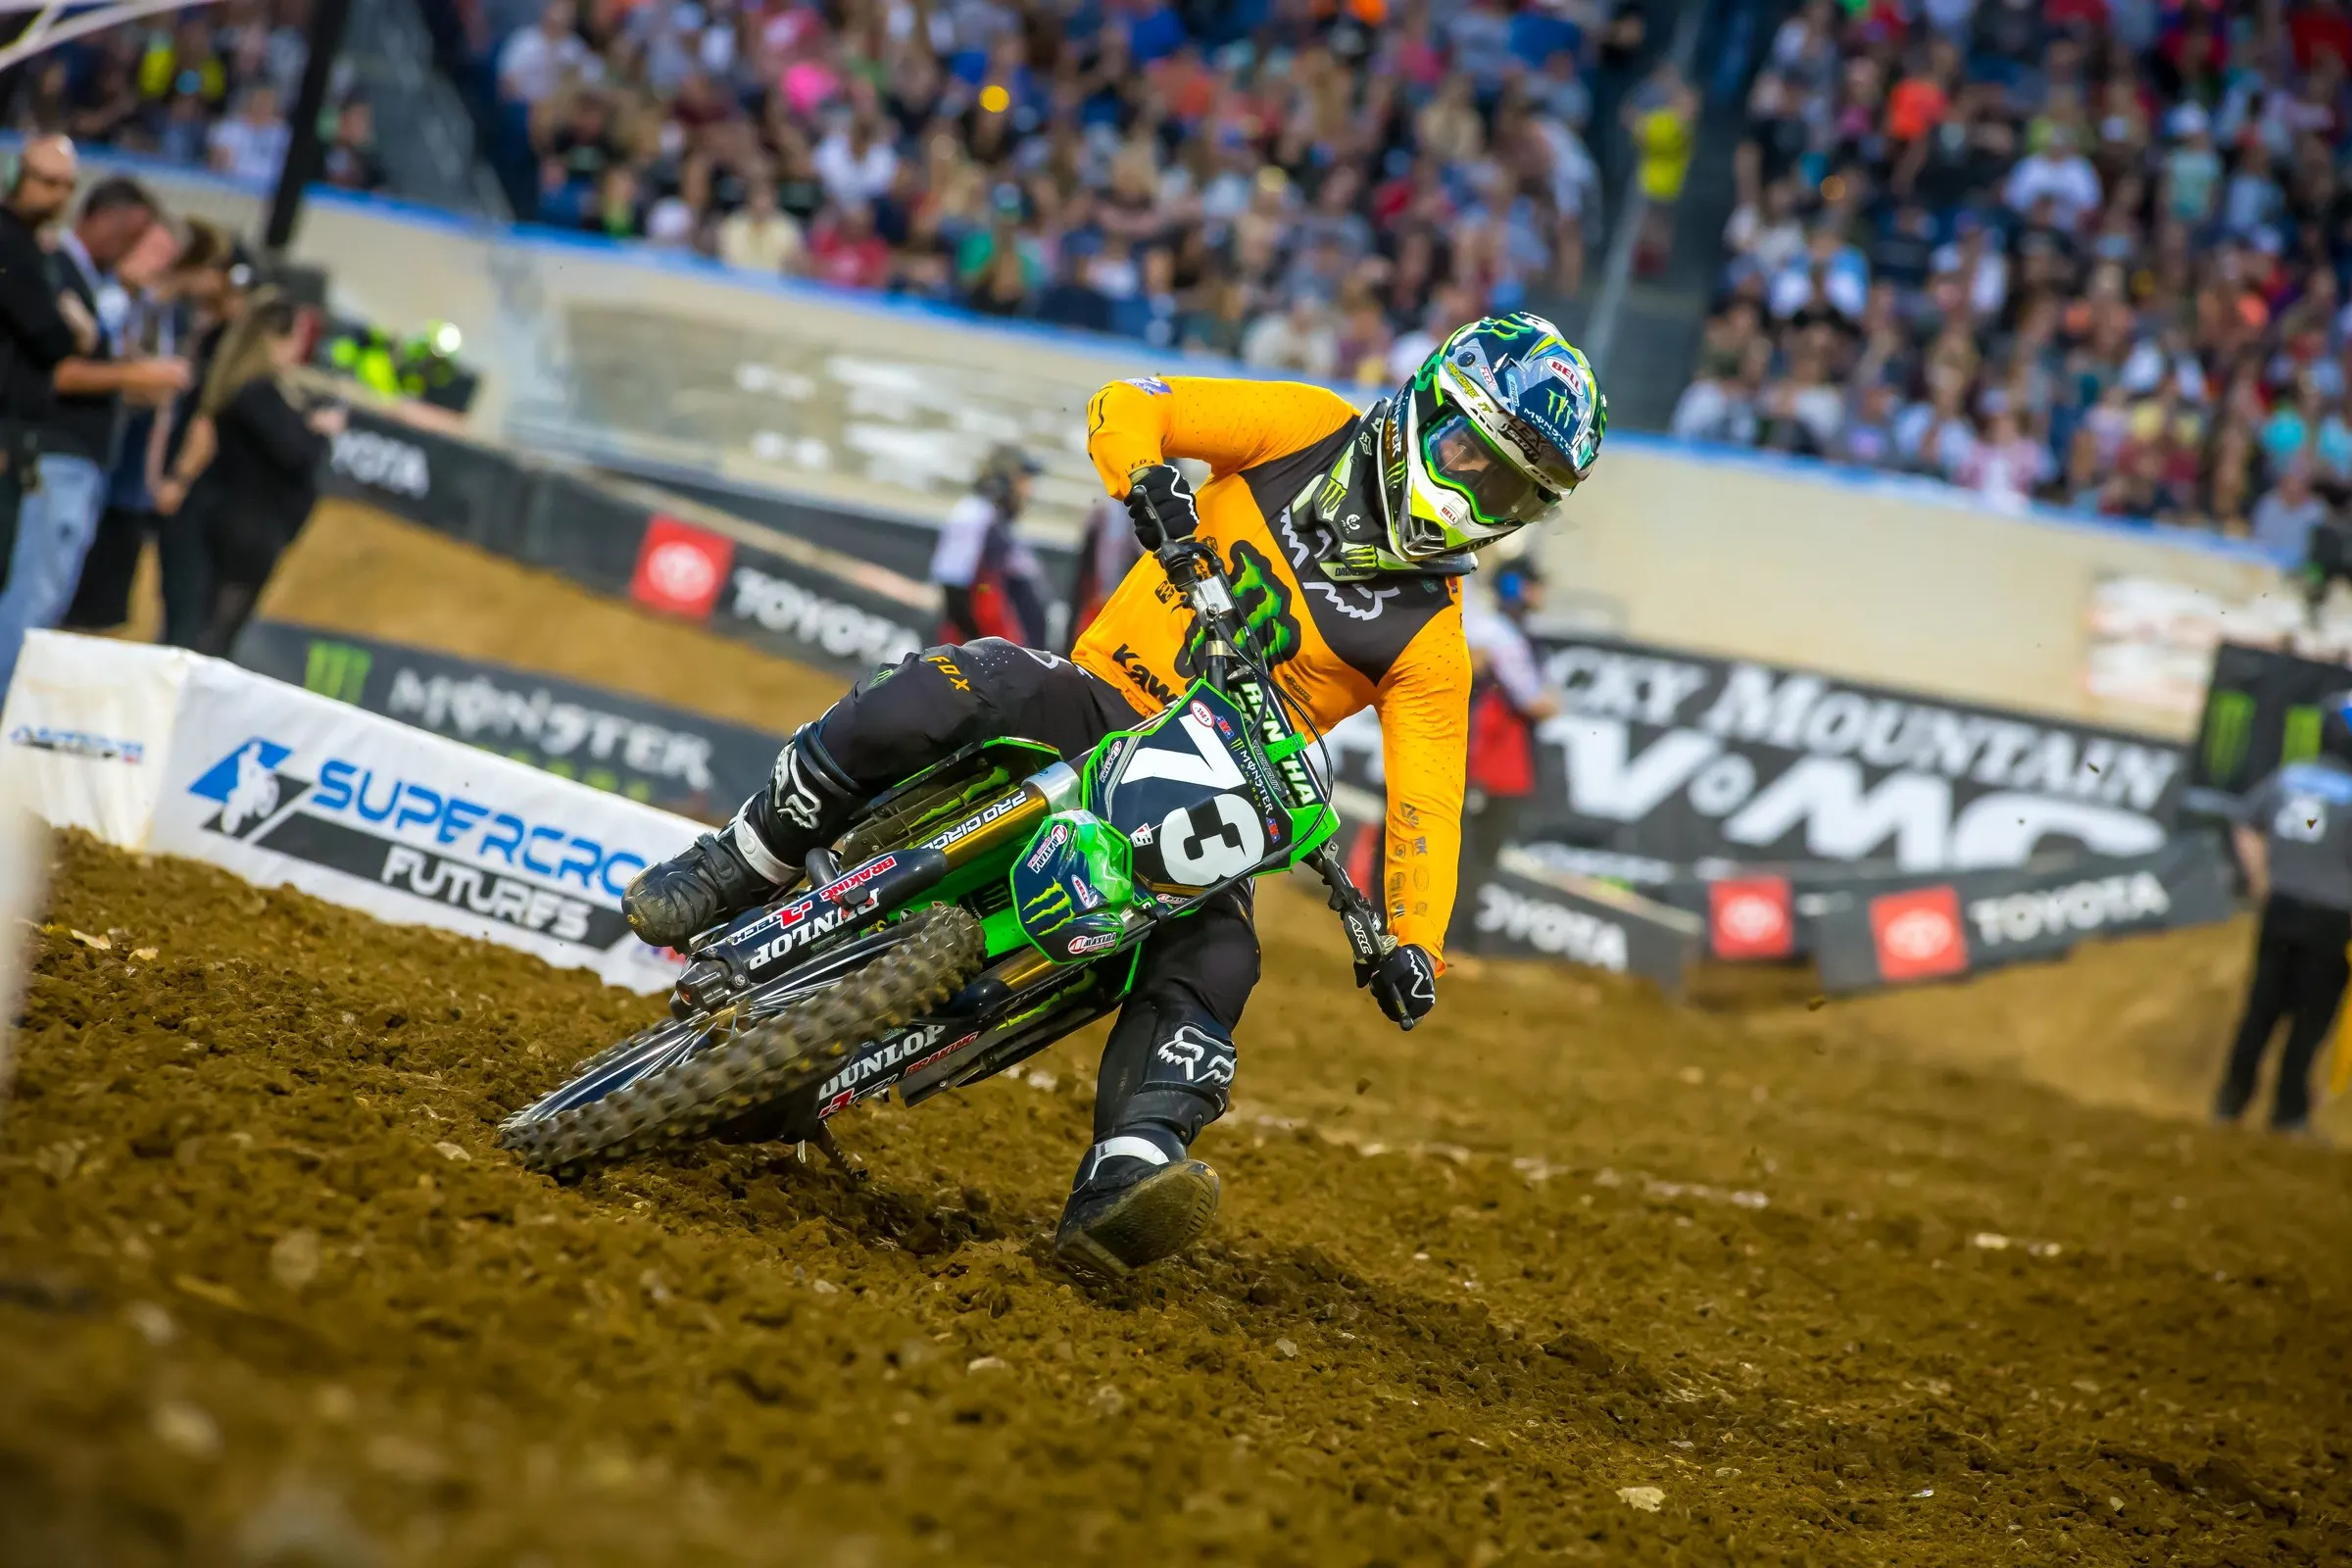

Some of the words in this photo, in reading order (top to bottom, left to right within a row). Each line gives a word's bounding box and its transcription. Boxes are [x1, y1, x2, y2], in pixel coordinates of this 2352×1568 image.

[1551, 360, 1580, 390] BELL
[1523, 408, 1574, 454] MONSTE
[1441, 506, 1457, 523] BELL
[732, 566, 923, 668] TOYOTA
[927, 656, 970, 692] FOX
[388, 668, 715, 791] MONSTER
[1239, 681, 1318, 806] RENHA
[983, 790, 1028, 823] PRO
[1120, 714, 1265, 886] 73
[1240, 750, 1274, 815] MONSTER
[1240, 763, 1261, 808] ENERGY
[313, 760, 649, 899] SUPERCRO
[381, 844, 592, 941] FUTURES
[821, 856, 896, 900] BRAKING
[1074, 879, 1089, 902] BELL
[1348, 914, 1373, 955] ARC
[1970, 872, 2170, 947] TOYOTA
[819, 1024, 946, 1101] DUNLOP
